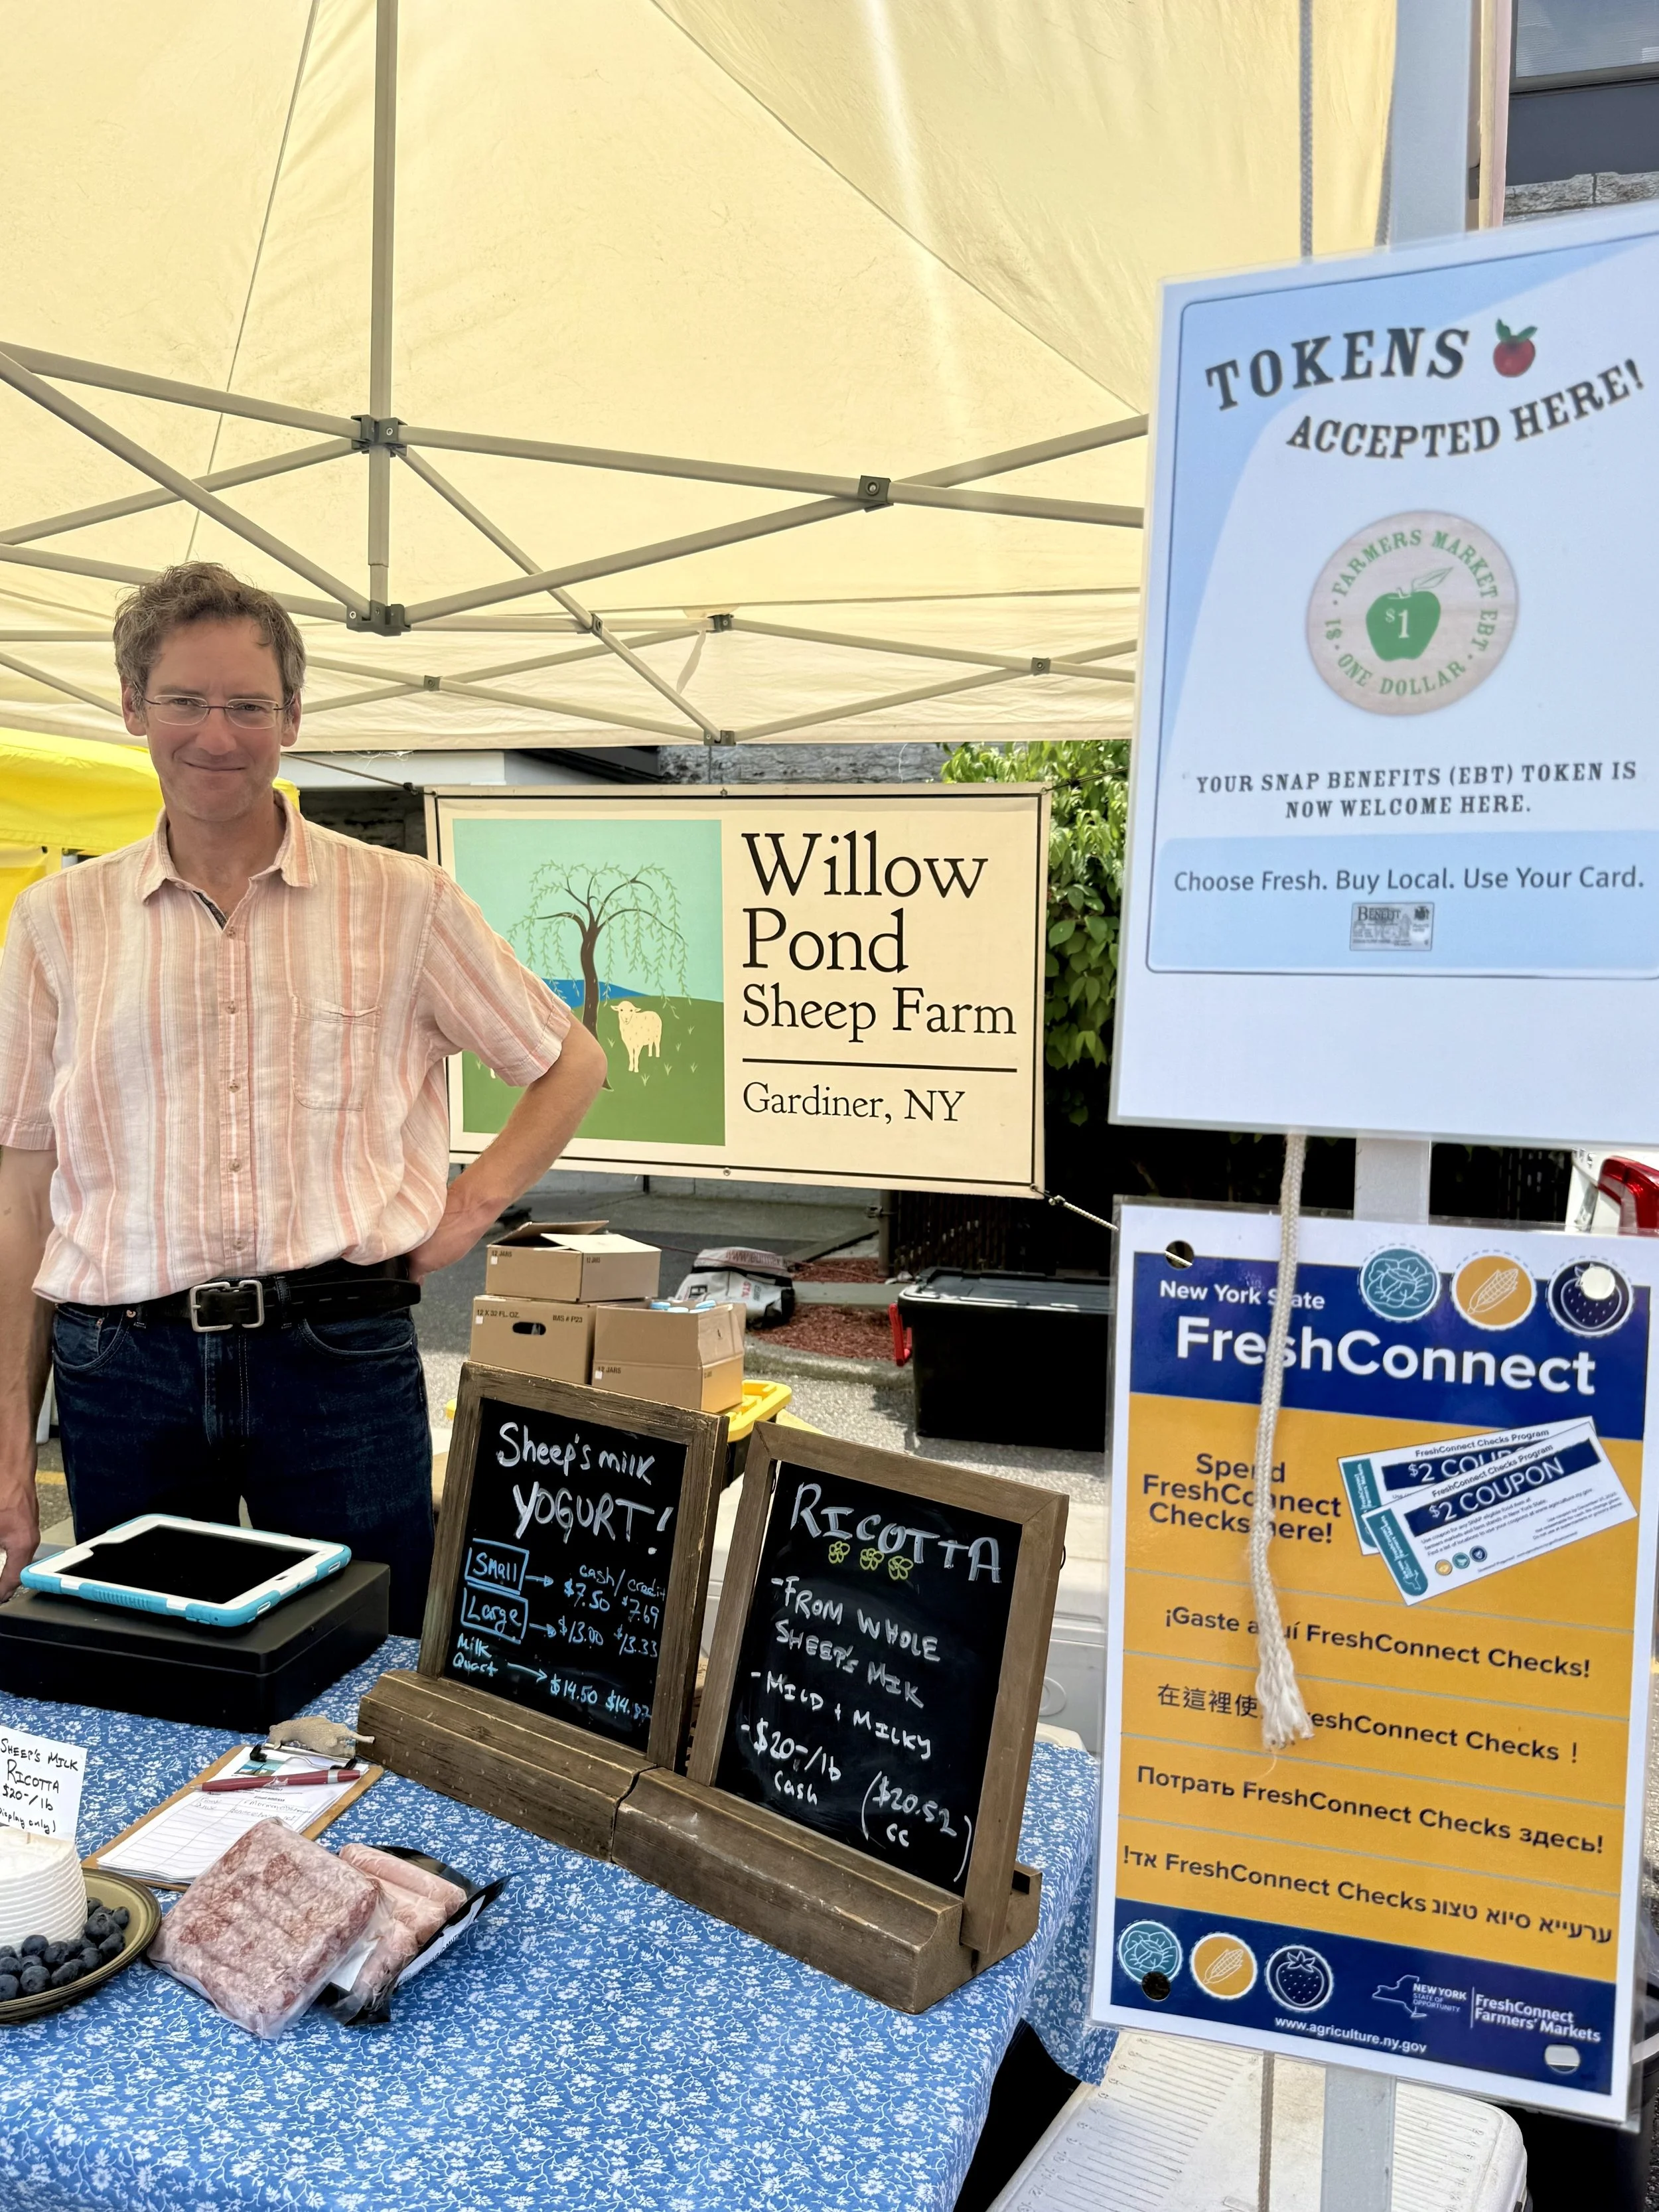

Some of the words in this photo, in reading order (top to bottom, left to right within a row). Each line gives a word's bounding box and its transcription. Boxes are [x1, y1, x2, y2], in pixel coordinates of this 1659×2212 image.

[1206, 327, 1469, 411] TOKENS
[1287, 415, 1500, 459] ACCEPTED
[1510, 358, 1644, 441] HERE!
[1332, 530, 1421, 597] FARMERS
[1431, 530, 1498, 598] MARKET
[1471, 609, 1498, 652] EBT
[1385, 607, 1409, 638] $1
[1337, 653, 1373, 688] ONE
[1378, 660, 1467, 696] DOLLAR
[1196, 774, 1254, 793] YOUR
[1261, 772, 1320, 792] SNAP
[1328, 767, 1441, 789] BENEFITS
[1450, 763, 1514, 786] (EBT)
[1521, 762, 1603, 783] TOKEN
[1612, 761, 1637, 780] IS
[1285, 799, 1334, 819] NOW
[1340, 796, 1452, 818] WELCOME
[1461, 794, 1532, 815] HERE.
[741, 830, 988, 900] Willow
[1173, 870, 1254, 893] Choose
[1262, 869, 1328, 891] Fresh.
[1336, 869, 1380, 895] Buy
[1388, 867, 1455, 891] Local.
[1463, 868, 1508, 890] Use
[1518, 866, 1572, 889] Your
[1579, 865, 1644, 889] Card.
[743, 907, 909, 974] Pond
[743, 982, 876, 1043] Sheep
[892, 986, 1017, 1035] Farm
[743, 1082, 893, 1125] Gardiner,
[904, 1088, 966, 1122] NY
[1159, 1280, 1208, 1301] New
[1213, 1284, 1262, 1305] York
[1267, 1288, 1326, 1310] Sate
[496, 1422, 592, 1477] Sheep's
[599, 1451, 656, 1486] milk
[1415, 1441, 1475, 1458] FreshConnect
[1477, 1435, 1510, 1447] Checks
[1511, 1429, 1550, 1442] Program
[1196, 1453, 1285, 1483] Sped
[1407, 1462, 1435, 1483] $2
[1431, 1467, 1486, 1498] FreshConnect
[1488, 1458, 1518, 1475] Checks
[1518, 1443, 1553, 1463] Program
[1429, 1501, 1457, 1522] $2
[1459, 1455, 1565, 1512] COUPON
[512, 1481, 674, 1555] YOGURT!
[790, 1481, 1002, 1584] RICOTTA
[1149, 1501, 1251, 1534] Checks
[467, 1595, 522, 1634] Large
[564, 1578, 611, 1611] $7.50
[621, 1595, 660, 1630] $7.69
[457, 1633, 492, 1659] Milk
[558, 1615, 604, 1646] $13.00
[857, 1608, 941, 1662] WHOLE
[1165, 1606, 1240, 1633] ¡Gaste
[1248, 1620, 1301, 1641] aí
[1307, 1623, 1480, 1664] FreshConnect
[1488, 1647, 1591, 1680] Checks!
[550, 1673, 598, 1706] $14.50
[853, 1710, 931, 1760] MILKY
[1157, 1682, 1263, 1720] 在這裡使
[1309, 1711, 1459, 1748] eshConnect
[1465, 1730, 1560, 1763] Checks
[0, 1737, 41, 1763] SHEEP'S
[48, 1751, 79, 1771] MILK
[7, 1758, 60, 1794] RICOTTA
[1137, 1765, 1236, 1798] Потрать
[1242, 1780, 1412, 1825] FreshConnect
[1419, 1807, 1511, 1840] Checks
[1518, 1826, 1605, 1855] здесь!
[1166, 1852, 1331, 1897] FreshConnect
[1338, 1880, 1427, 1913] Checks
[1412, 1999, 1461, 2012] OPPORTUNITY
[1413, 1982, 1437, 1995] NEW
[1438, 1986, 1467, 2002] YORK
[1413, 1993, 1433, 2002] STATE
[1475, 1993, 1575, 2024] FreshConnect
[1275, 2015, 1427, 2054] www.agriculture.ny.gov
[1475, 2008, 1540, 2031] Farmers'
[1540, 2018, 1602, 2043] Markets
